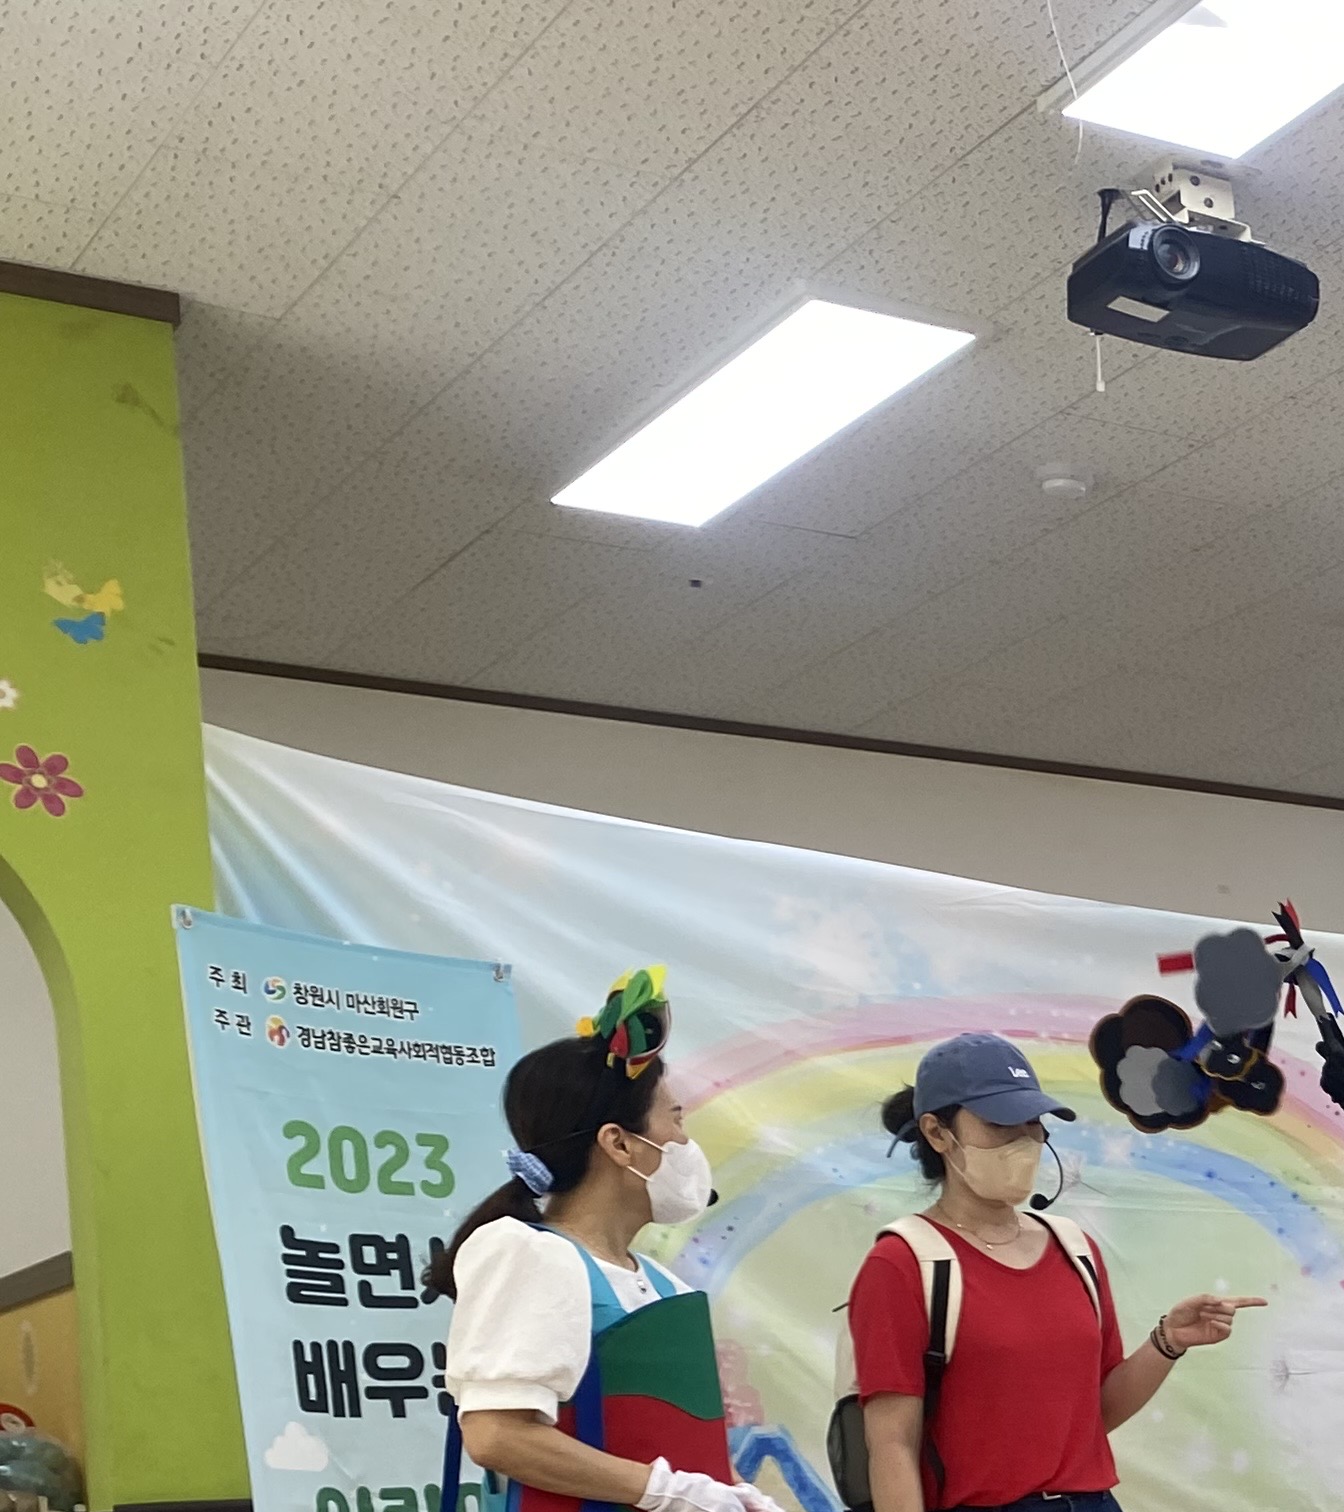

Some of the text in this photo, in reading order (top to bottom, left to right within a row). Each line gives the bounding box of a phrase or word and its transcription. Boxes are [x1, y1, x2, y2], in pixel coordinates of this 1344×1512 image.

[293, 982, 341, 1011] 창원시
[346, 993, 420, 1021] 마산회원구
[297, 1025, 496, 1068] 경남참좋은교육사회적협동조합
[283, 1119, 456, 1199] 2023
